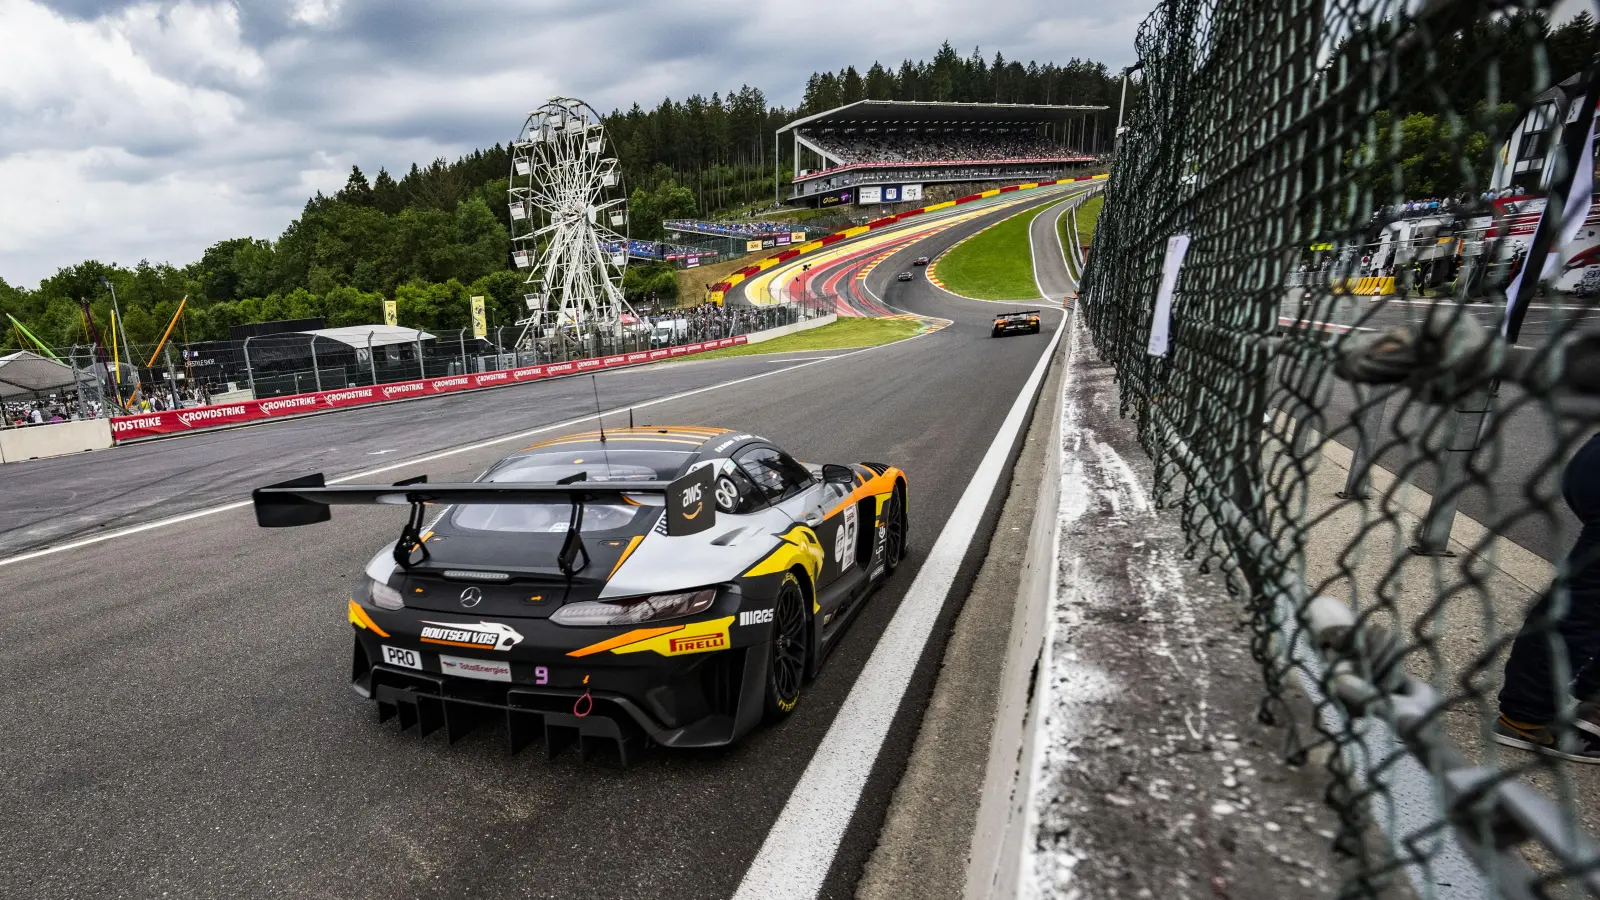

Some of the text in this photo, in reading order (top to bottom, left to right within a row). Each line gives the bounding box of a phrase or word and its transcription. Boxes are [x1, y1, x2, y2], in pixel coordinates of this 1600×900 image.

[385, 383, 424, 394] CROWDSTRIKE
[435, 378, 468, 388] CROWDSTRIKE
[262, 397, 316, 410] CROWDSTRIKE
[327, 389, 373, 402] CROWDSTRIKE
[183, 406, 246, 422] CROWDSTRIKE
[682, 482, 702, 508] aws
[420, 627, 498, 645] BOUTSEN VDS
[669, 632, 725, 653] PIRELLI
[388, 647, 416, 667] PRO
[458, 662, 510, 676] TotalEnergies
[534, 665, 549, 685] 9
